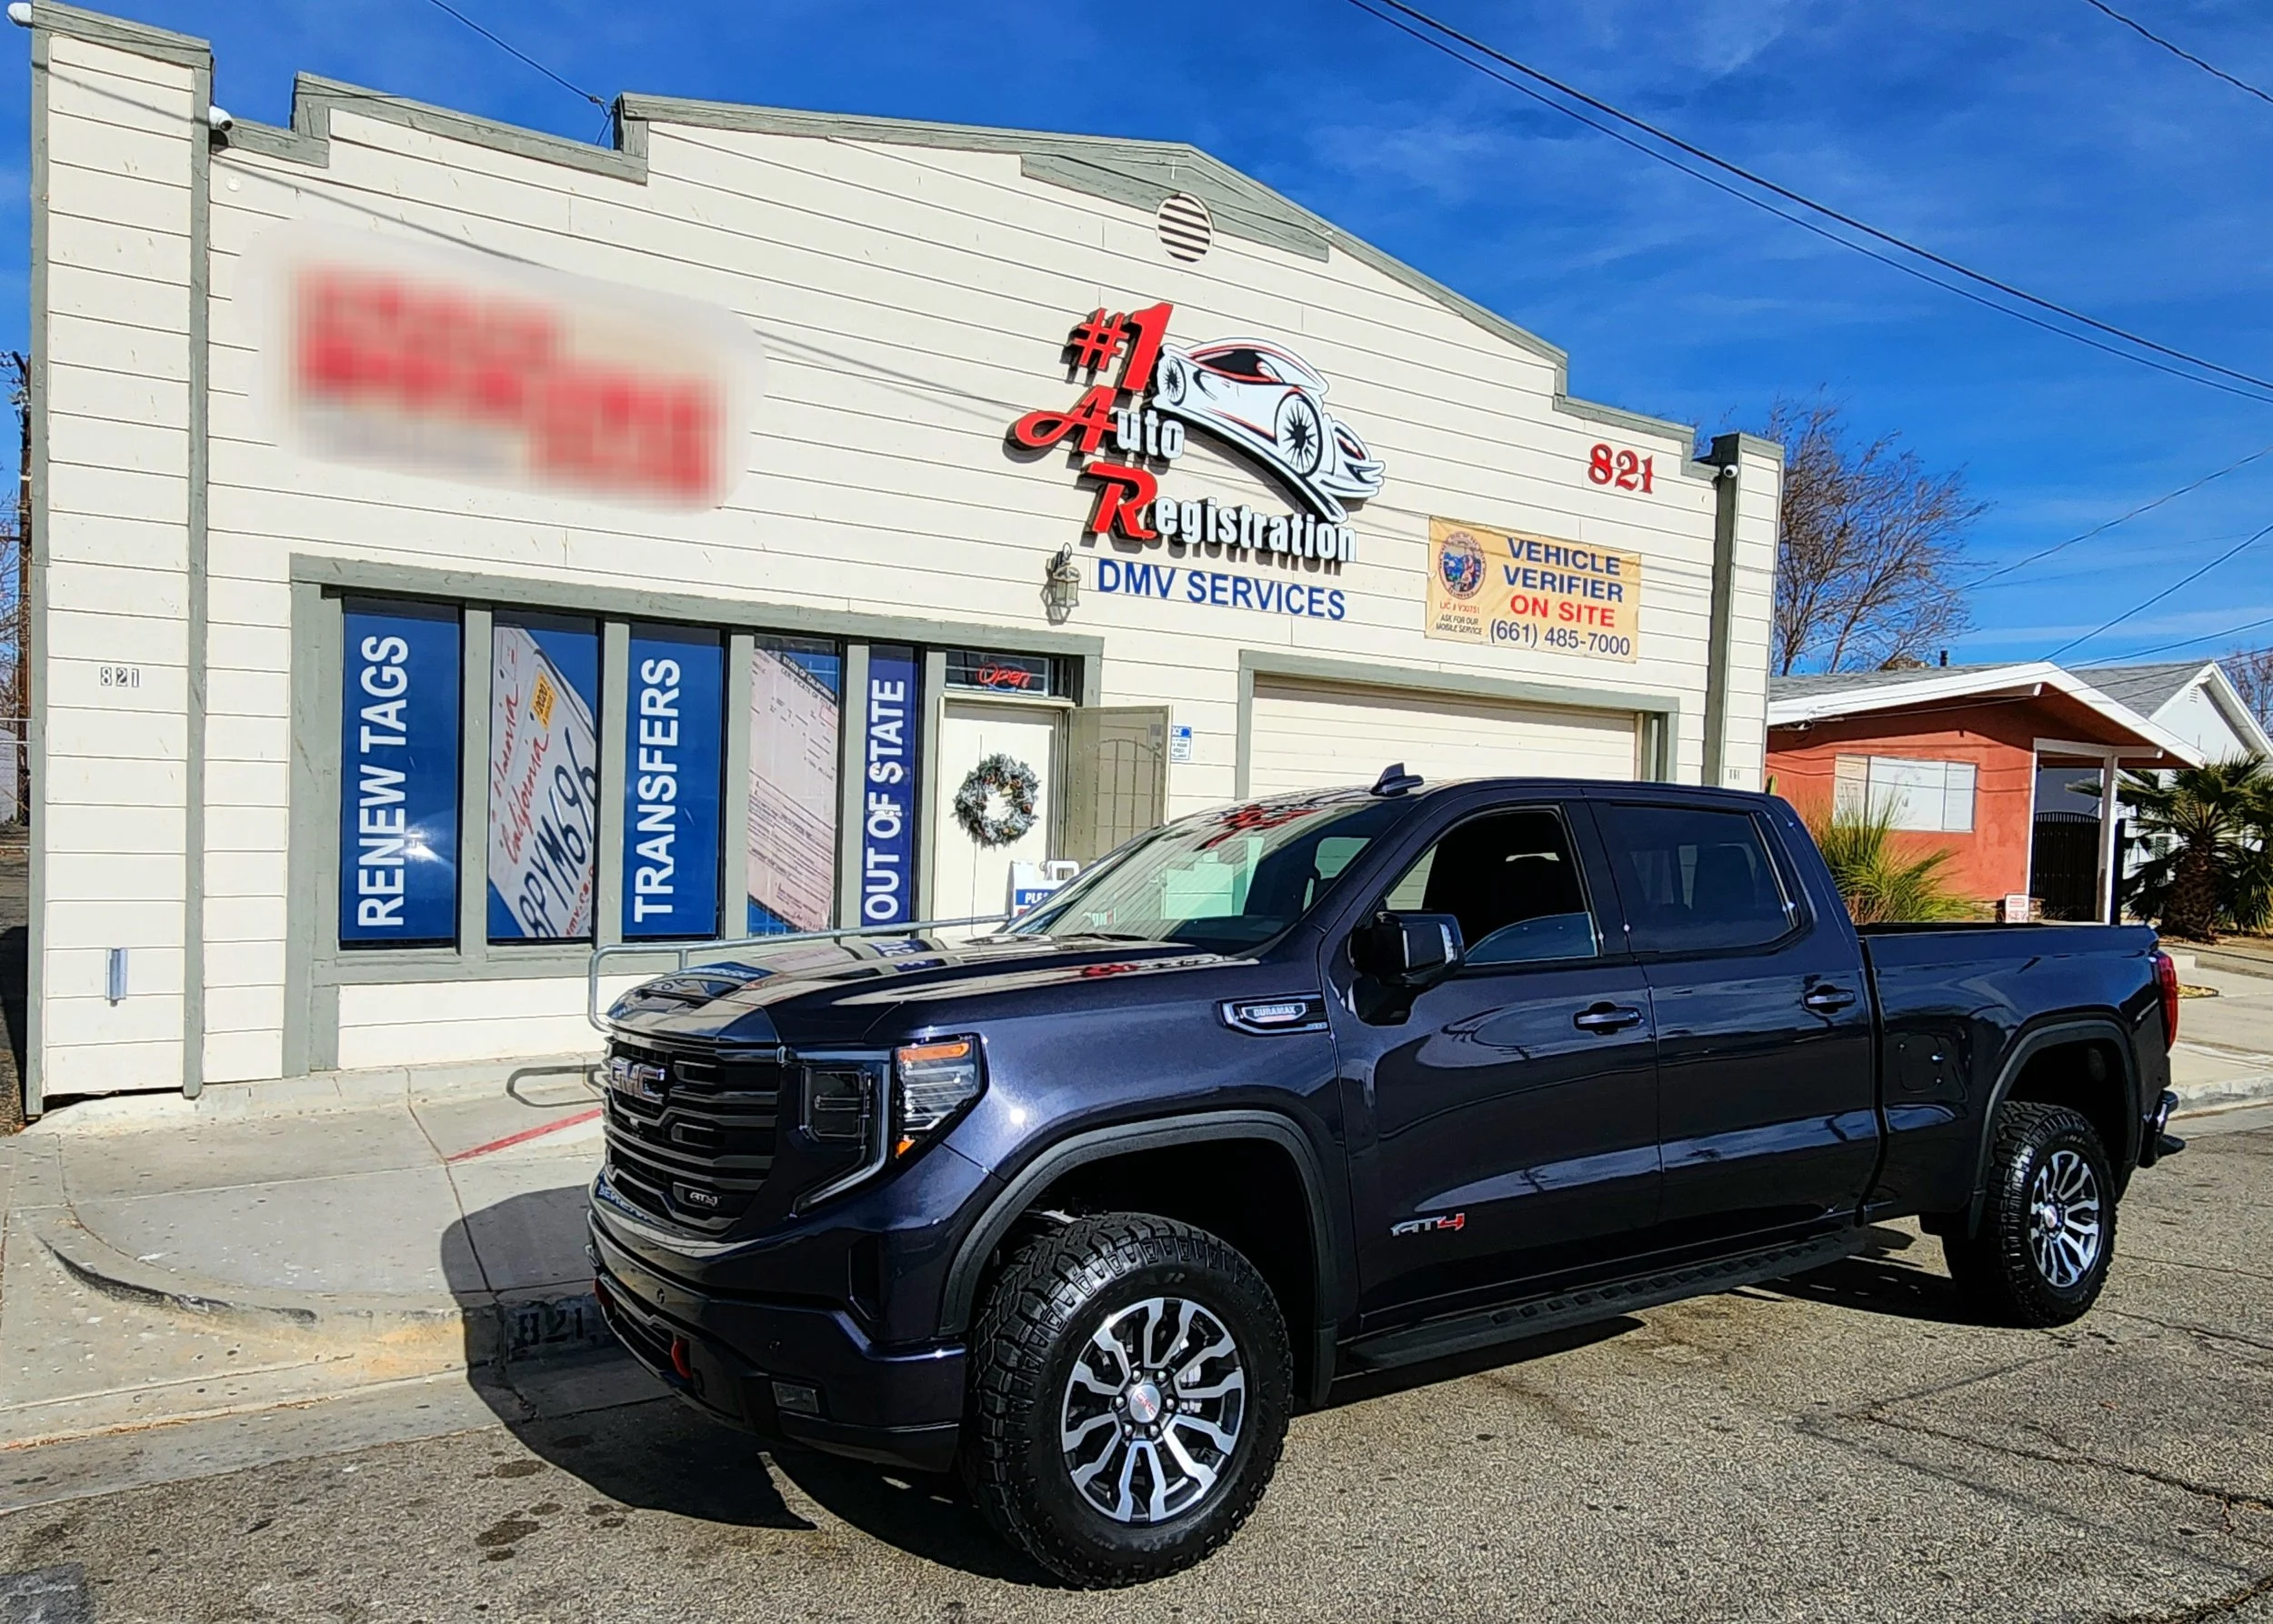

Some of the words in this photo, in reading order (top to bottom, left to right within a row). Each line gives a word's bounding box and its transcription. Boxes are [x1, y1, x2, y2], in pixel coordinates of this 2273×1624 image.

[1067, 302, 1174, 391] #1
[1015, 385, 1185, 459] Auto
[1587, 444, 1654, 495] 821
[1086, 461, 1357, 562] Registration
[1507, 537, 1621, 576] VEHICLE
[1097, 558, 1177, 598] DMV
[1187, 570, 1346, 620] SERVICES
[1503, 564, 1623, 602] VERIFIER
[1453, 616, 1466, 624] FOR
[1509, 594, 1548, 618] ON
[1558, 601, 1615, 627] SITE
[1490, 618, 1538, 648] (661)
[1544, 627, 1630, 657] 485-7000
[100, 667, 139, 687] 821
[360, 636, 409, 754] TAGS
[979, 663, 1030, 688] Open
[868, 679, 905, 785] STATE
[501, 733, 550, 865] California
[634, 658, 681, 923] TRANSFERS
[867, 792, 902, 839] OF
[357, 763, 406, 927] RENEW
[864, 847, 900, 920] OUT
[1253, 1006, 1297, 1018] DURAMAX
[611, 1056, 666, 1106] GMC
[1390, 1213, 1465, 1237] AT4
